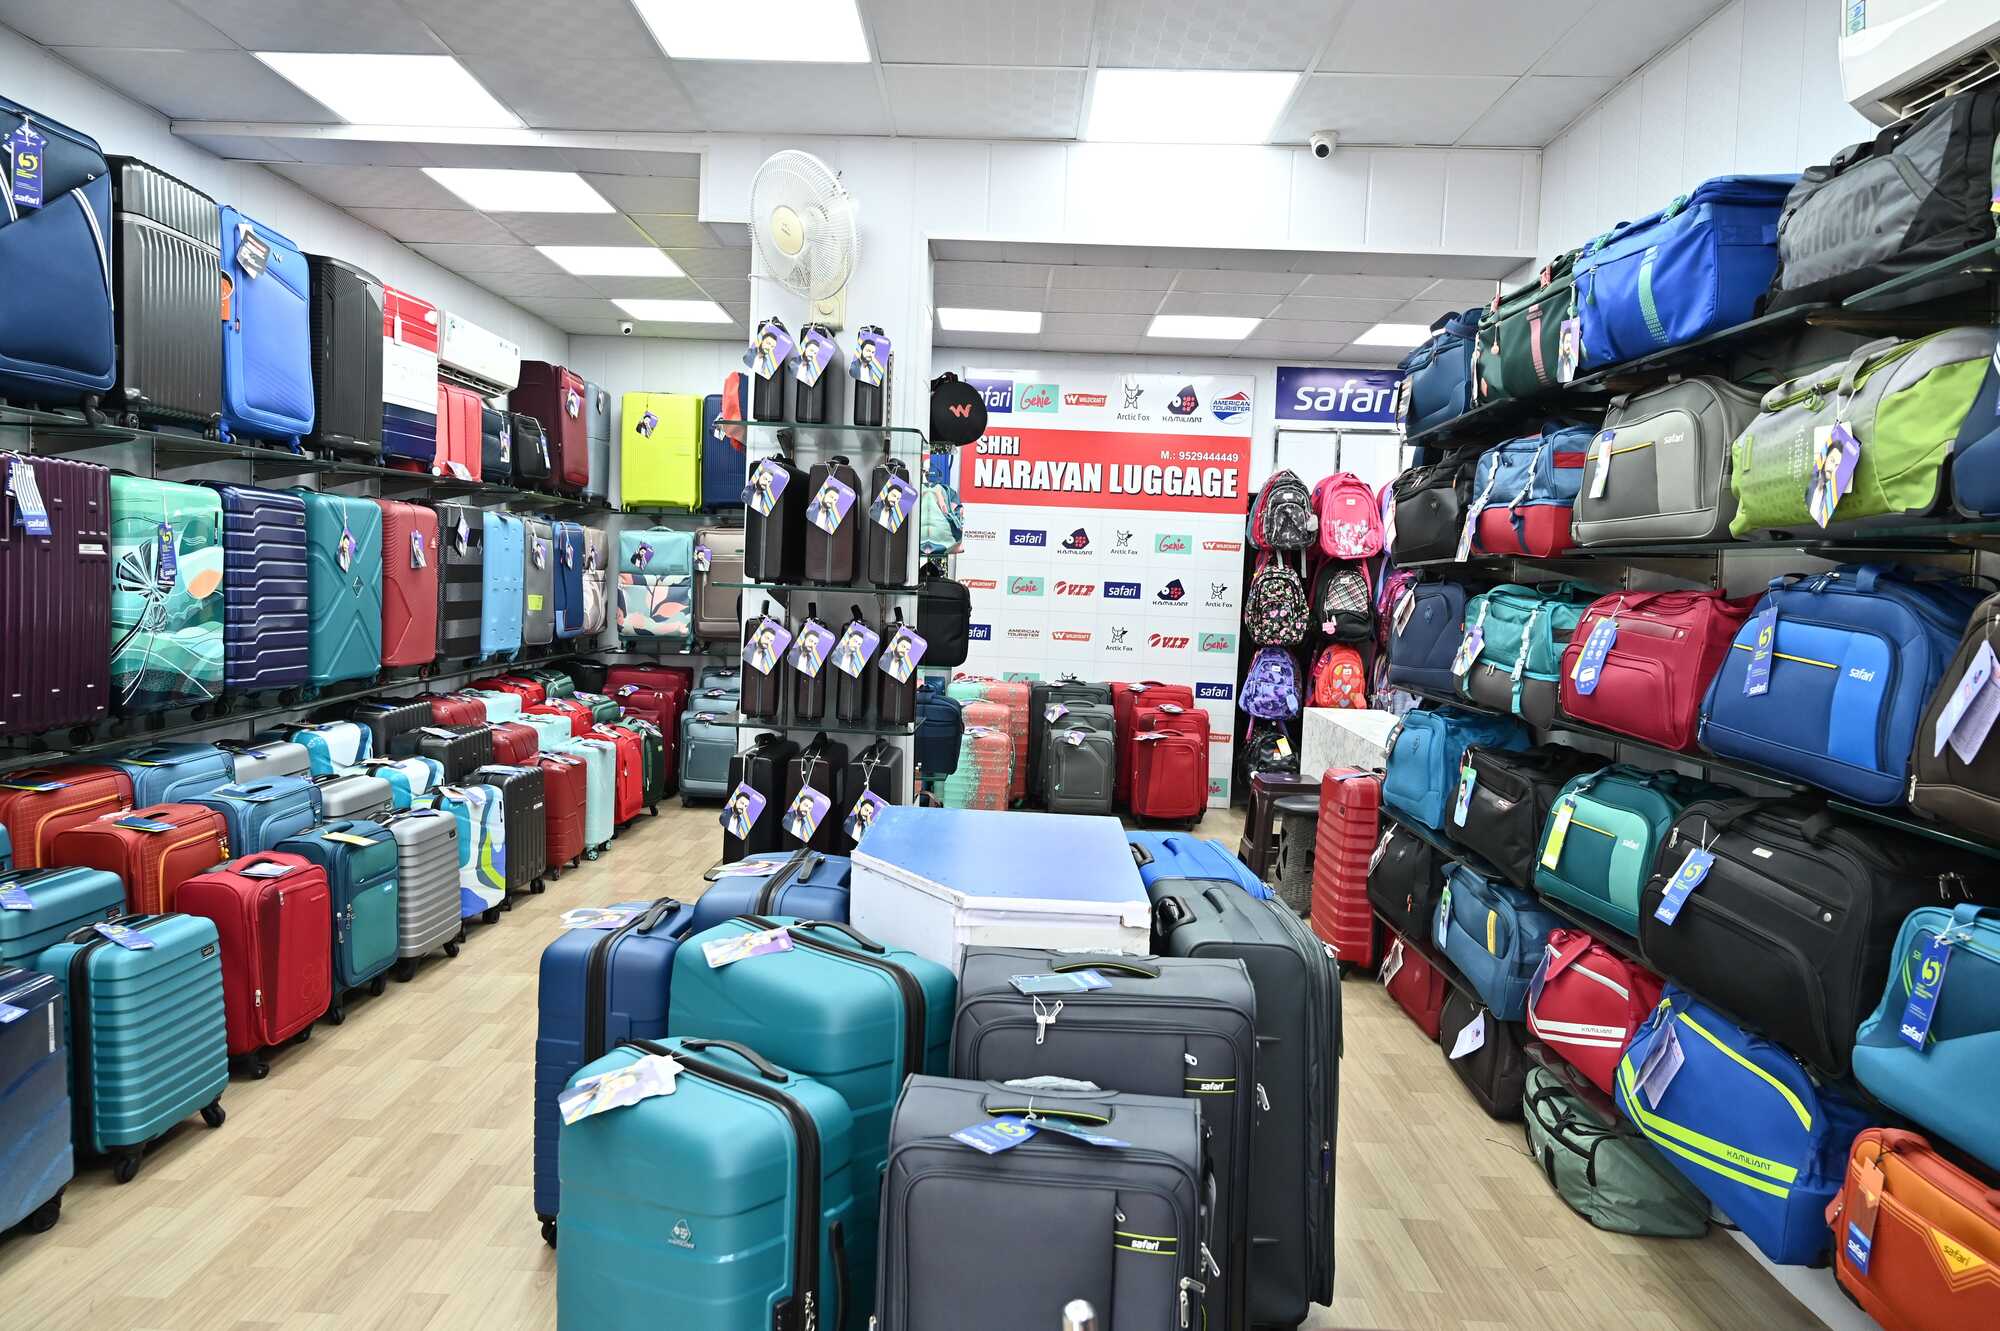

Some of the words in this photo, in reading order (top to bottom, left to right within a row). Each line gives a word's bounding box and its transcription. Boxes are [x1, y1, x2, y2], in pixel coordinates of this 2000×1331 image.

[14, 194, 40, 205] safari
[978, 386, 1012, 408] fari
[1020, 384, 1052, 410] Genie
[1293, 379, 1402, 413] safari
[1116, 412, 1137, 421] Arctic
[1138, 413, 1150, 422] Fox
[1663, 431, 1685, 444] safari
[975, 435, 1020, 456] SHRI
[1179, 452, 1239, 462] 9529444449
[974, 458, 1103, 493] NARAYAN
[1109, 463, 1239, 499] LUGGAGE
[1014, 533, 1042, 544] safari
[1159, 535, 1185, 553] Genie
[1011, 576, 1038, 594] Genie
[1108, 586, 1137, 597] safari
[968, 626, 988, 638] afari
[1105, 644, 1122, 652] Arctic
[1202, 633, 1229, 651] Genie
[1849, 667, 1875, 682] safari
[1199, 686, 1229, 697] safari
[1749, 682, 1767, 695] safari
[1200, 1082, 1225, 1091] safari
[1726, 1149, 1774, 1171] KAMILIANT
[1131, 1240, 1160, 1251] safari
[1943, 1244, 1972, 1266] safari
